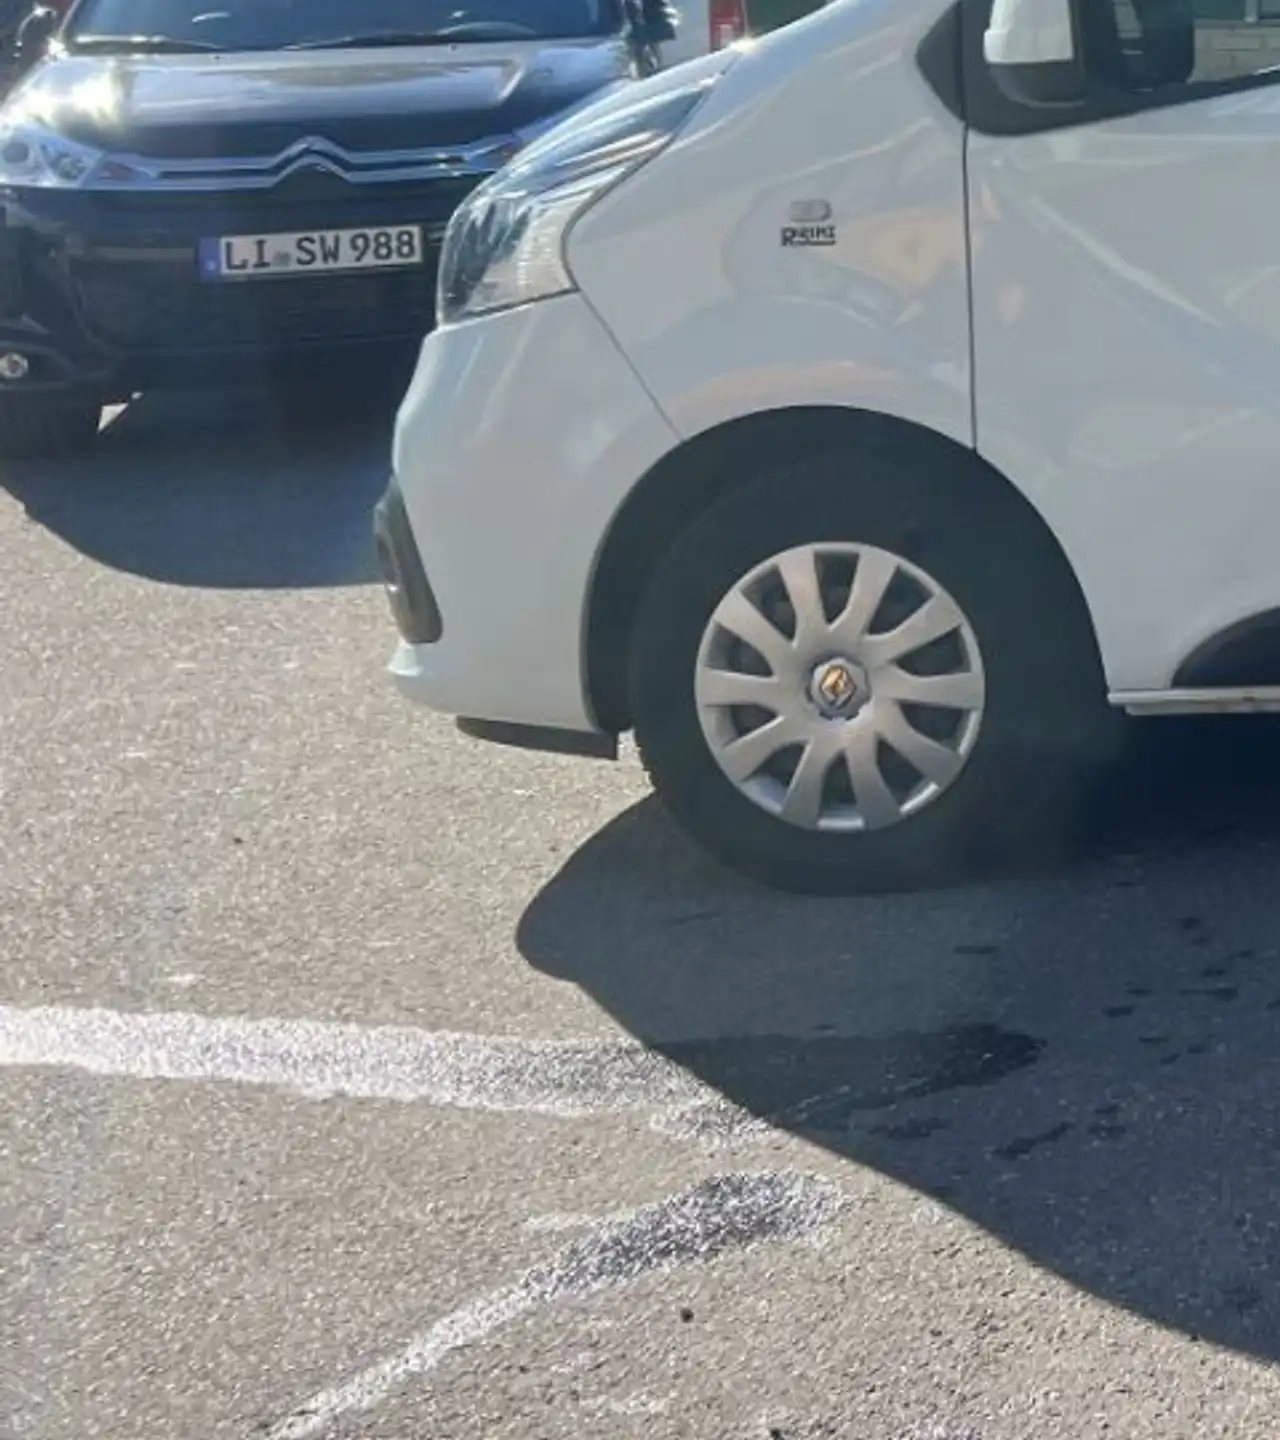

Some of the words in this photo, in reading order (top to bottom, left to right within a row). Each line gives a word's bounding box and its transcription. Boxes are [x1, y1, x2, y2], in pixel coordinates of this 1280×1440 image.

[225, 239, 270, 270] LI
[296, 233, 340, 266] SW
[350, 229, 417, 262] 988
